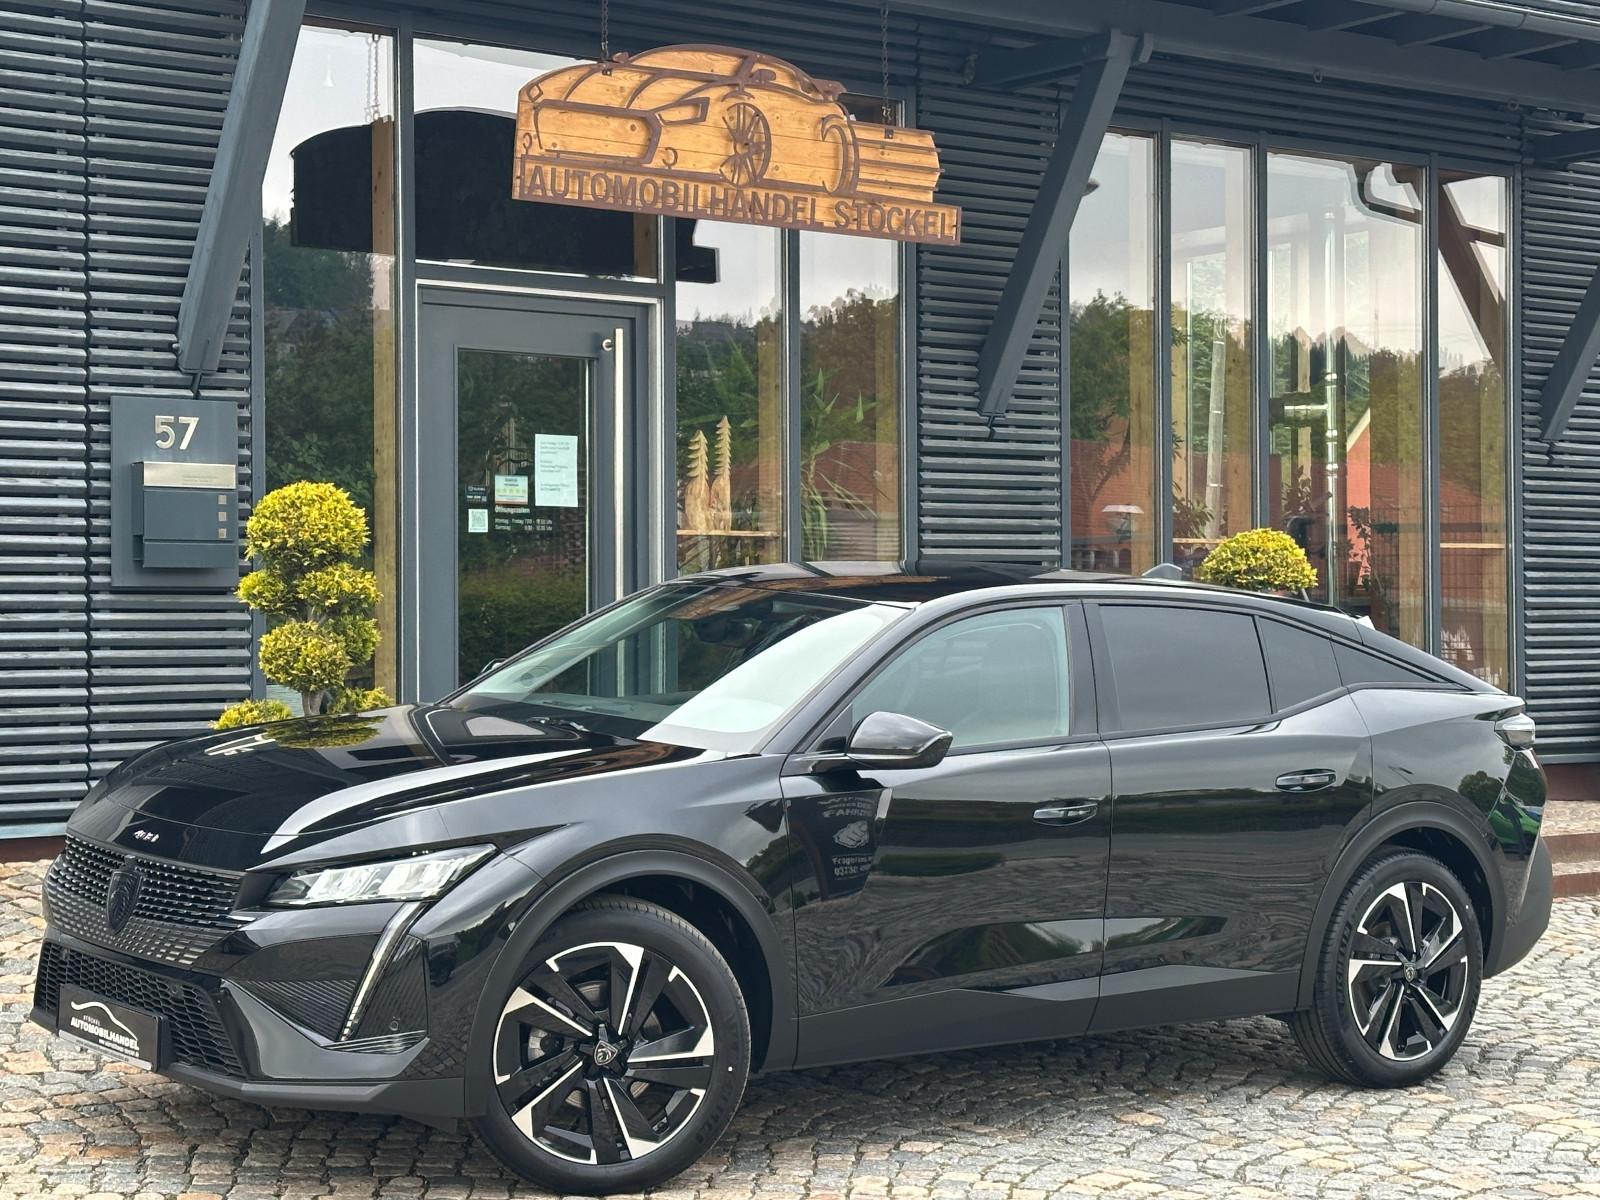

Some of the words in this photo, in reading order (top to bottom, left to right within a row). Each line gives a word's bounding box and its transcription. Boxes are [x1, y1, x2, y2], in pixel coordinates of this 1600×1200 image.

[526, 164, 825, 229] AUTOMOBILHANDEL
[154, 415, 200, 450] 57
[70, 1016, 140, 1052] AUTOMOBILHANDEL
